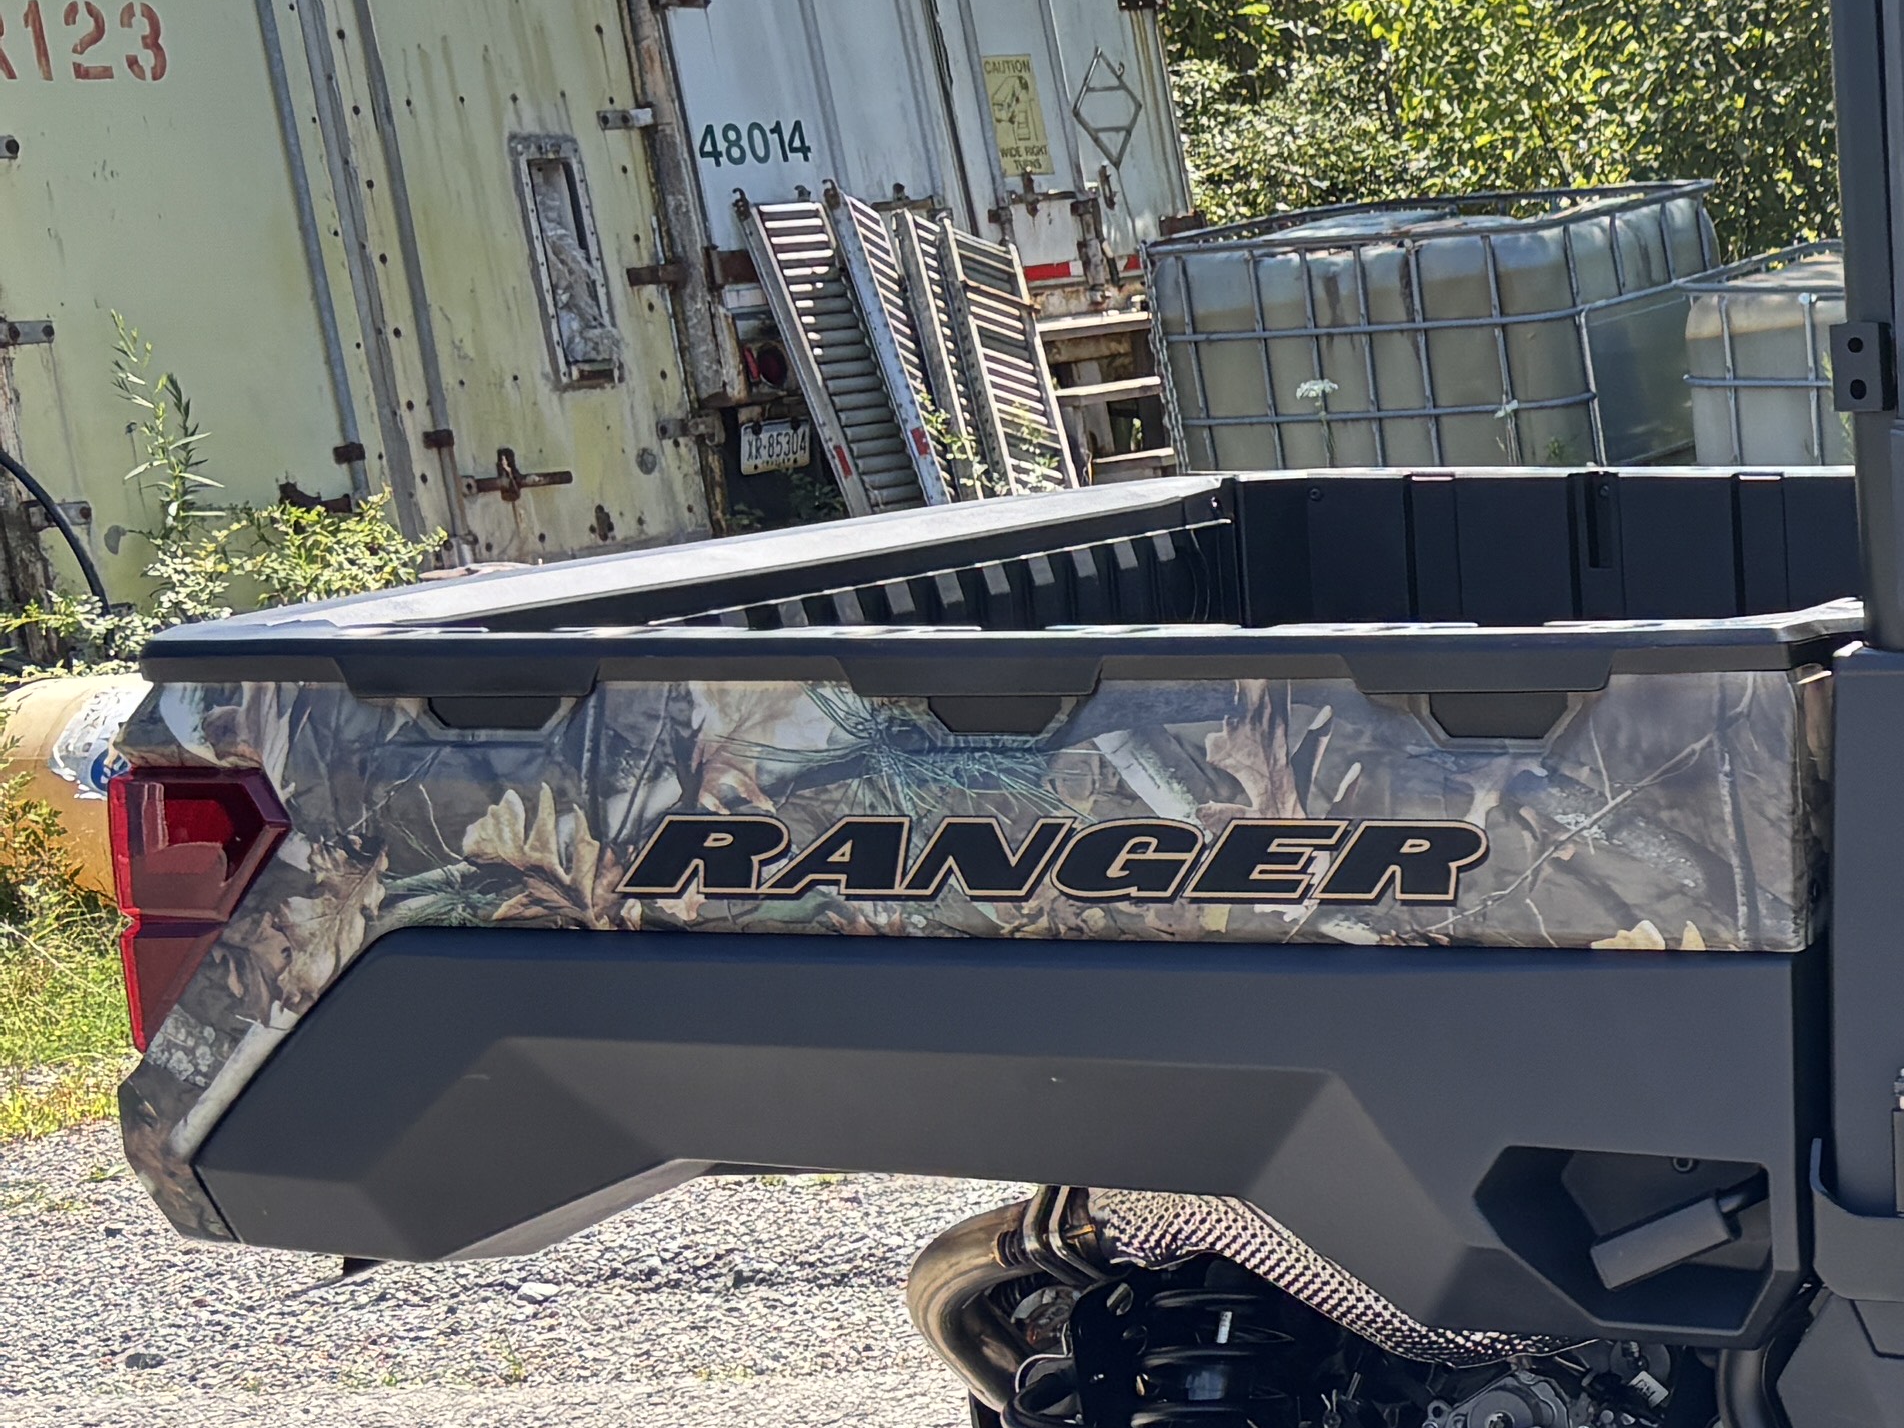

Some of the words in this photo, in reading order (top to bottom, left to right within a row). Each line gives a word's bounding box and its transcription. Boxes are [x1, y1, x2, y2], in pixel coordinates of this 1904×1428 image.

[984, 59, 1031, 74] CAUTION
[699, 120, 811, 167] 48014
[616, 815, 1491, 906] RANGER
